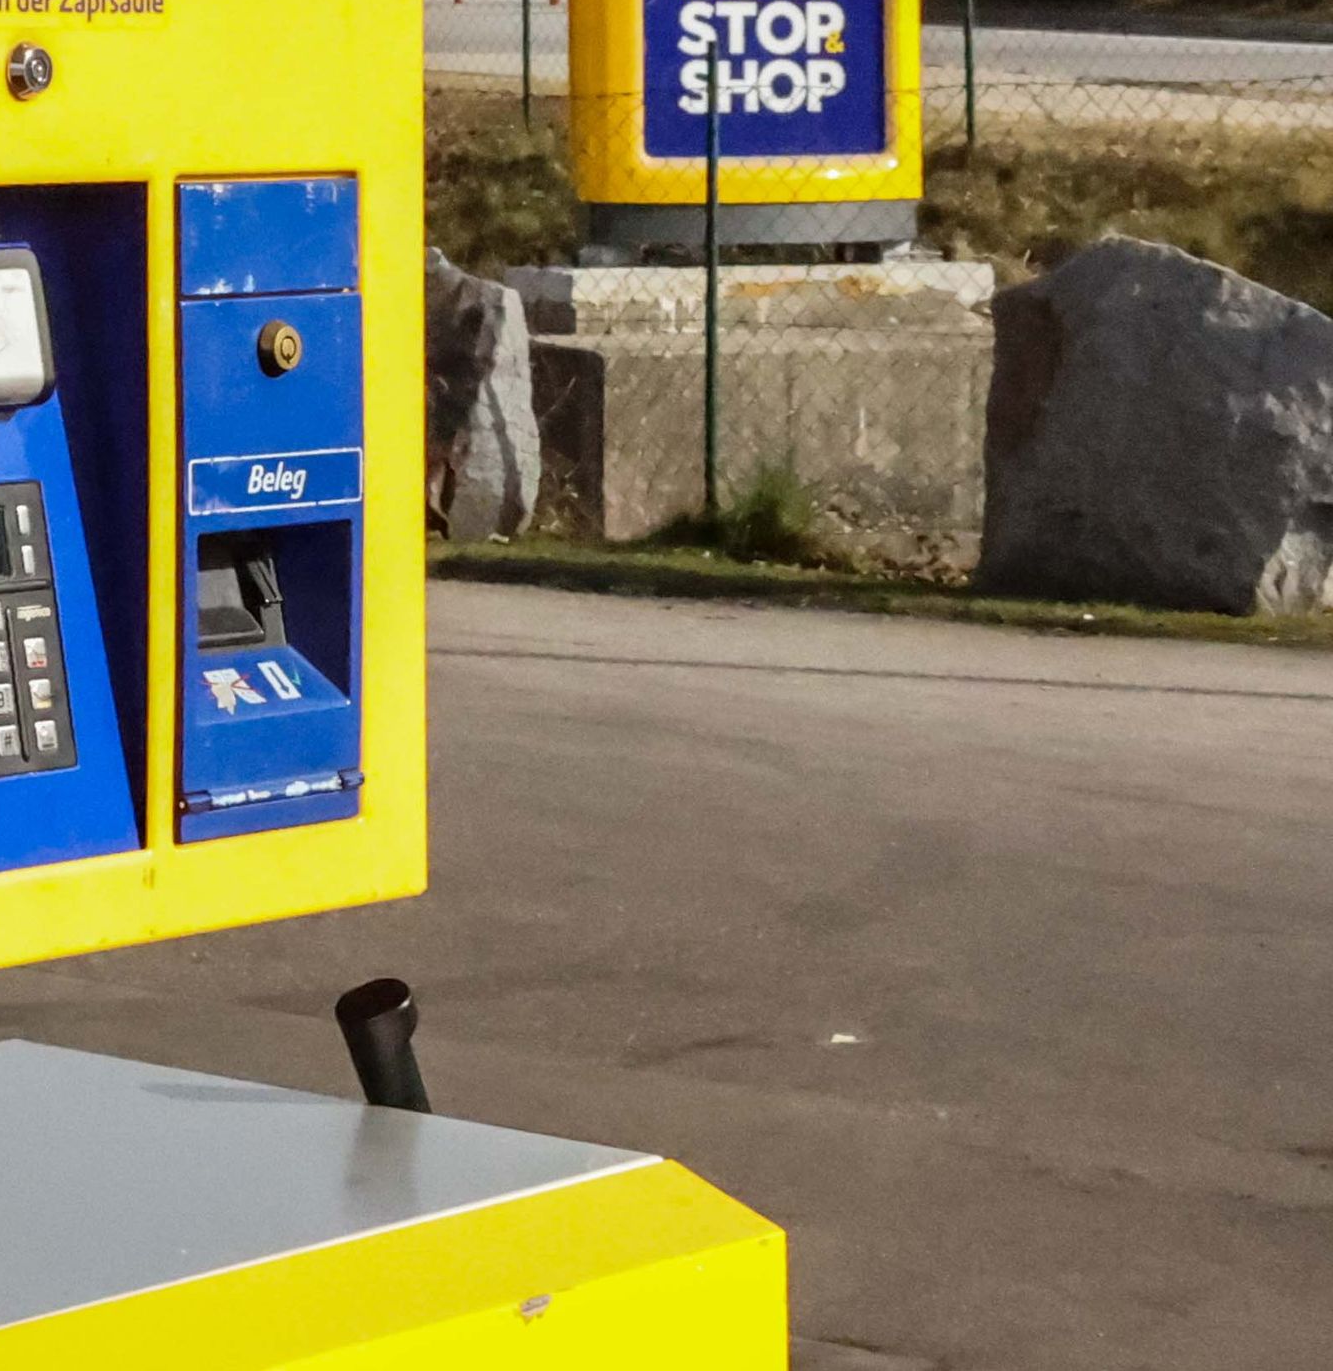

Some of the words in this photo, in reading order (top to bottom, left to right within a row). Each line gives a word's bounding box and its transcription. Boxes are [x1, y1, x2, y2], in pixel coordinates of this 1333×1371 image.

[677, 1, 845, 55] STOP
[678, 59, 846, 115] SHOP
[248, 461, 307, 499] Beleg
